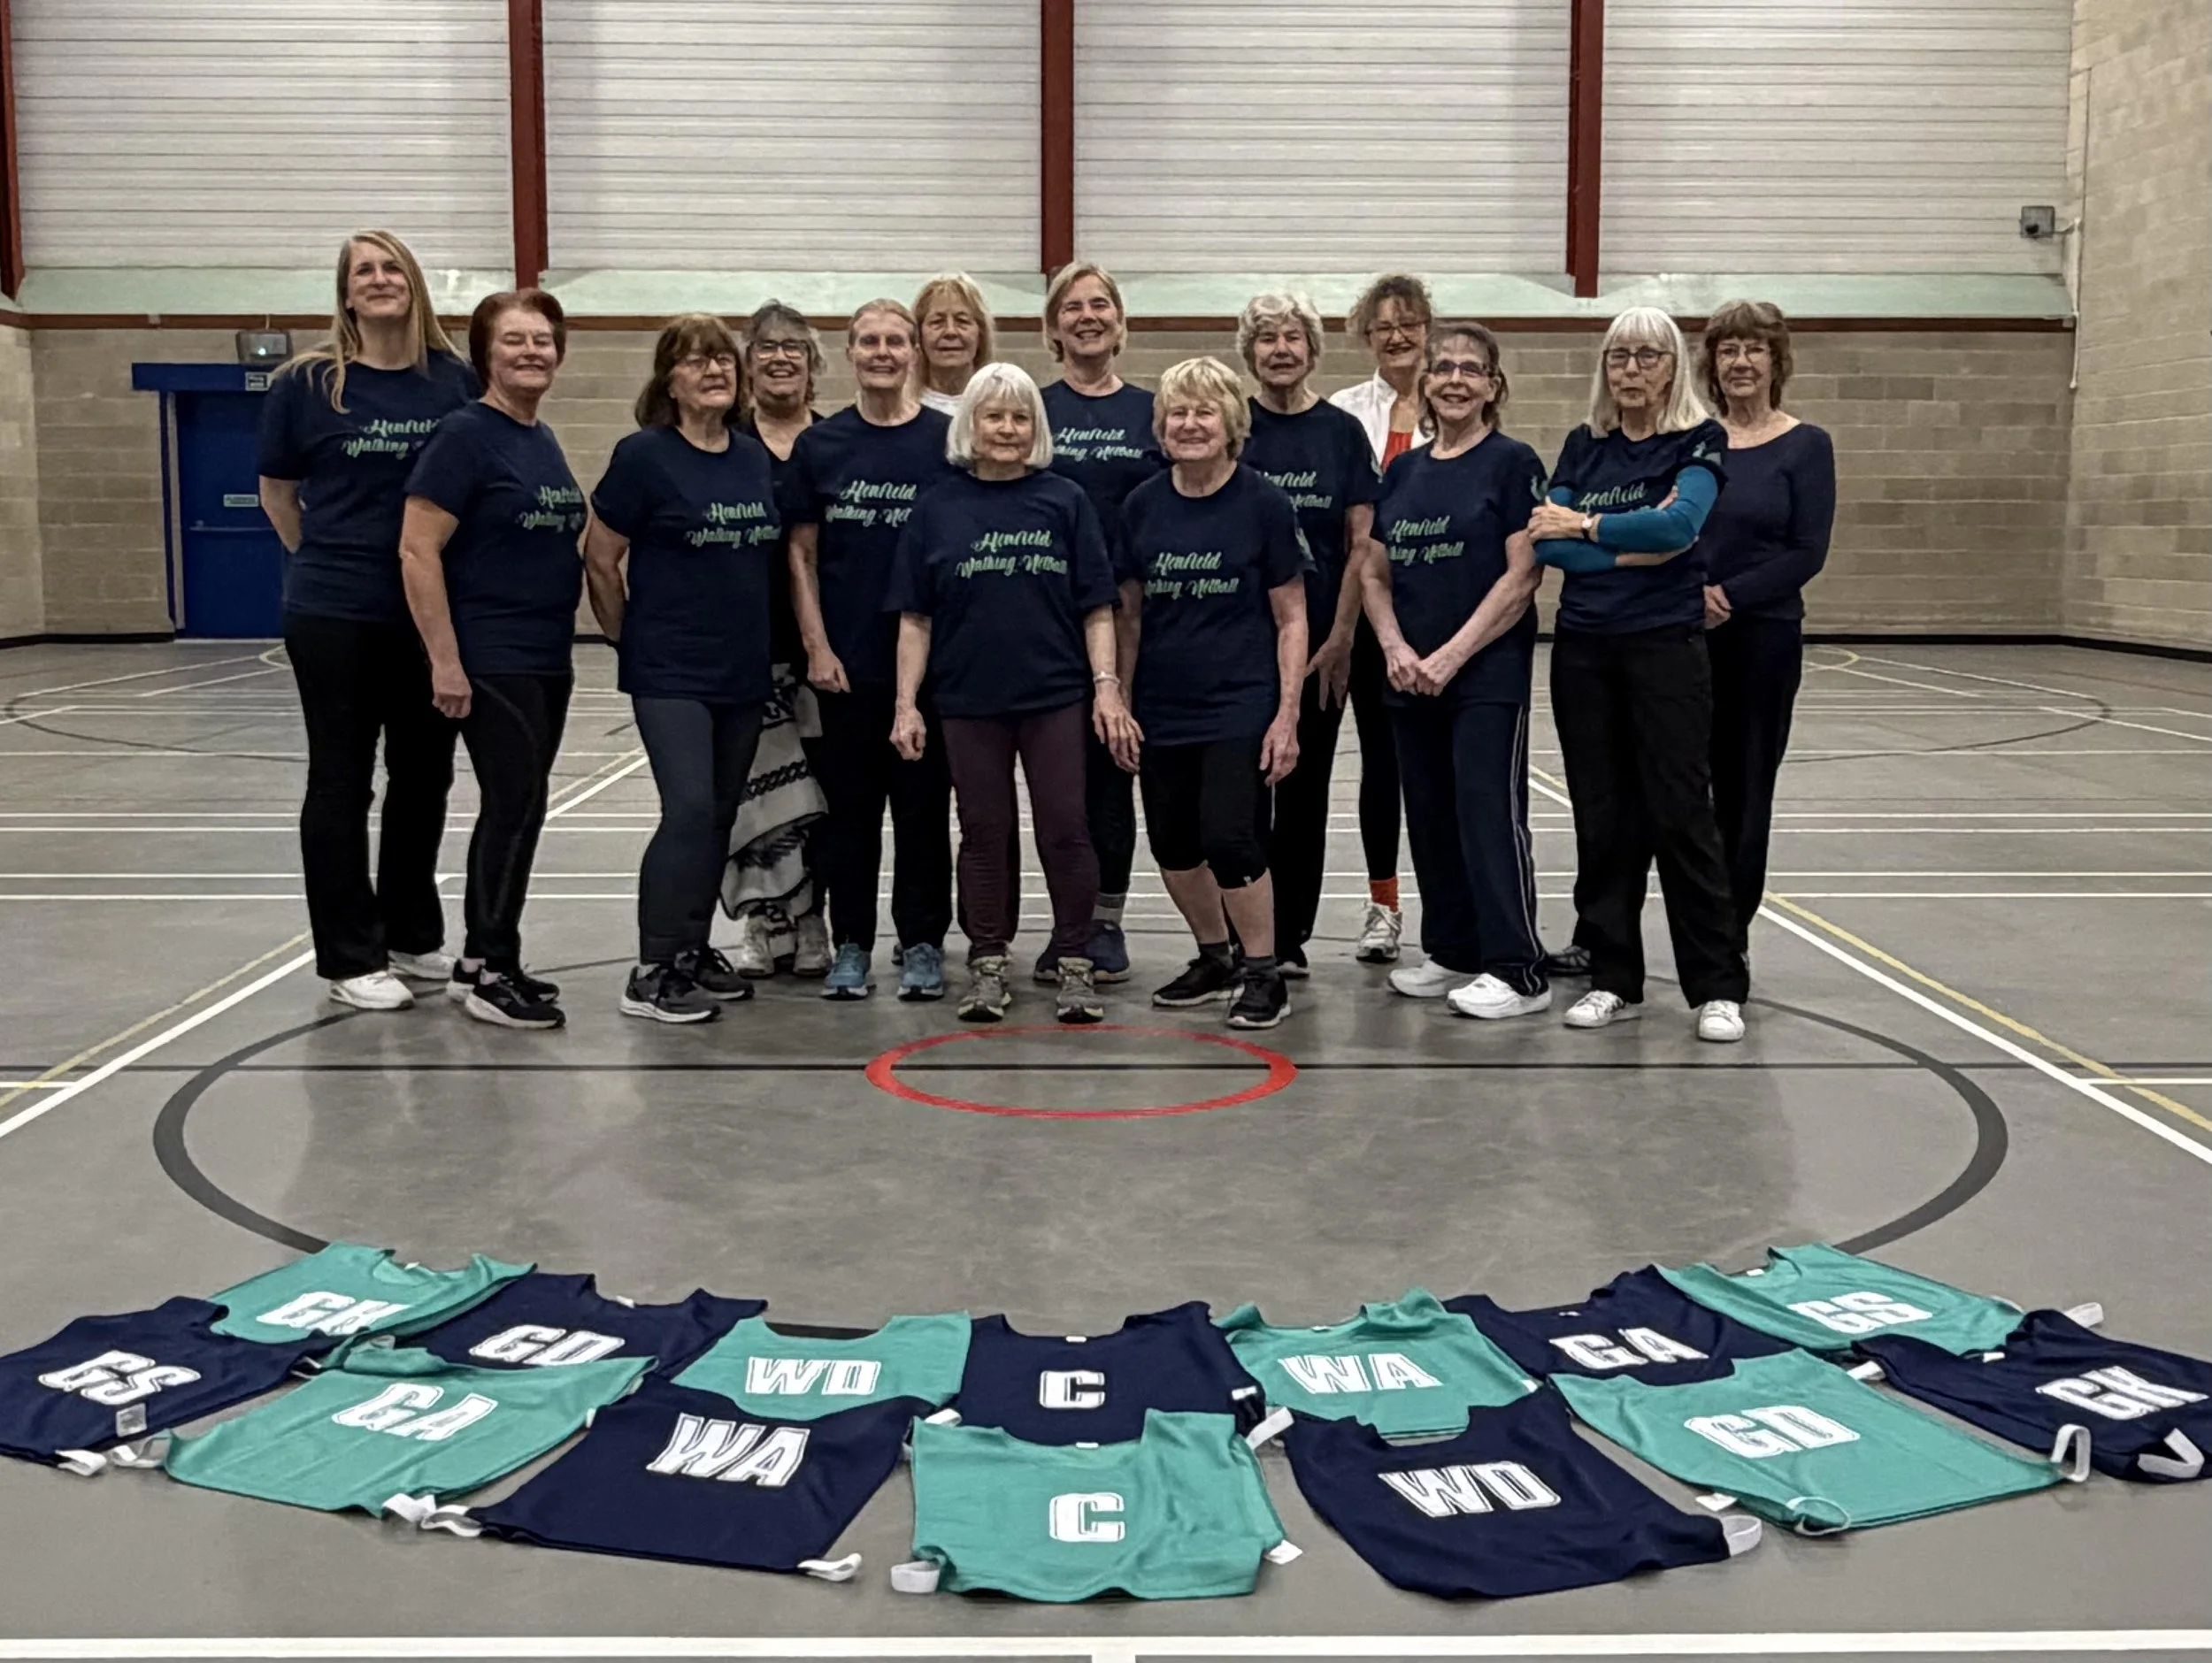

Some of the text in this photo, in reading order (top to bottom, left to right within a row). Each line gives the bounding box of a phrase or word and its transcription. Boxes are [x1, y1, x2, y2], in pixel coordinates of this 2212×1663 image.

[1055, 426, 1126, 444] Henfield
[841, 479, 918, 503] Henfield
[971, 530, 1052, 553] Henfield
[1386, 515, 1450, 543] Henfield
[955, 556, 1017, 579] Walking
[1149, 552, 1222, 576] Henfield
[1185, 578, 1240, 599] Netball
[257, 1291, 411, 1335] GK
[1786, 1291, 1933, 1335] GS
[468, 1324, 625, 1365] GD
[1549, 1327, 1709, 1368] GA
[38, 1350, 202, 1406] GS
[746, 1356, 881, 1395] WD
[1039, 1369, 1105, 1409] C
[1278, 1353, 1444, 1394] WA
[2036, 1365, 2210, 1421] GK
[332, 1383, 498, 1442] GA
[1684, 1405, 1861, 1459] GD
[646, 1412, 810, 1487] WA
[1378, 1460, 1562, 1518] WD
[1049, 1491, 1125, 1543] C
